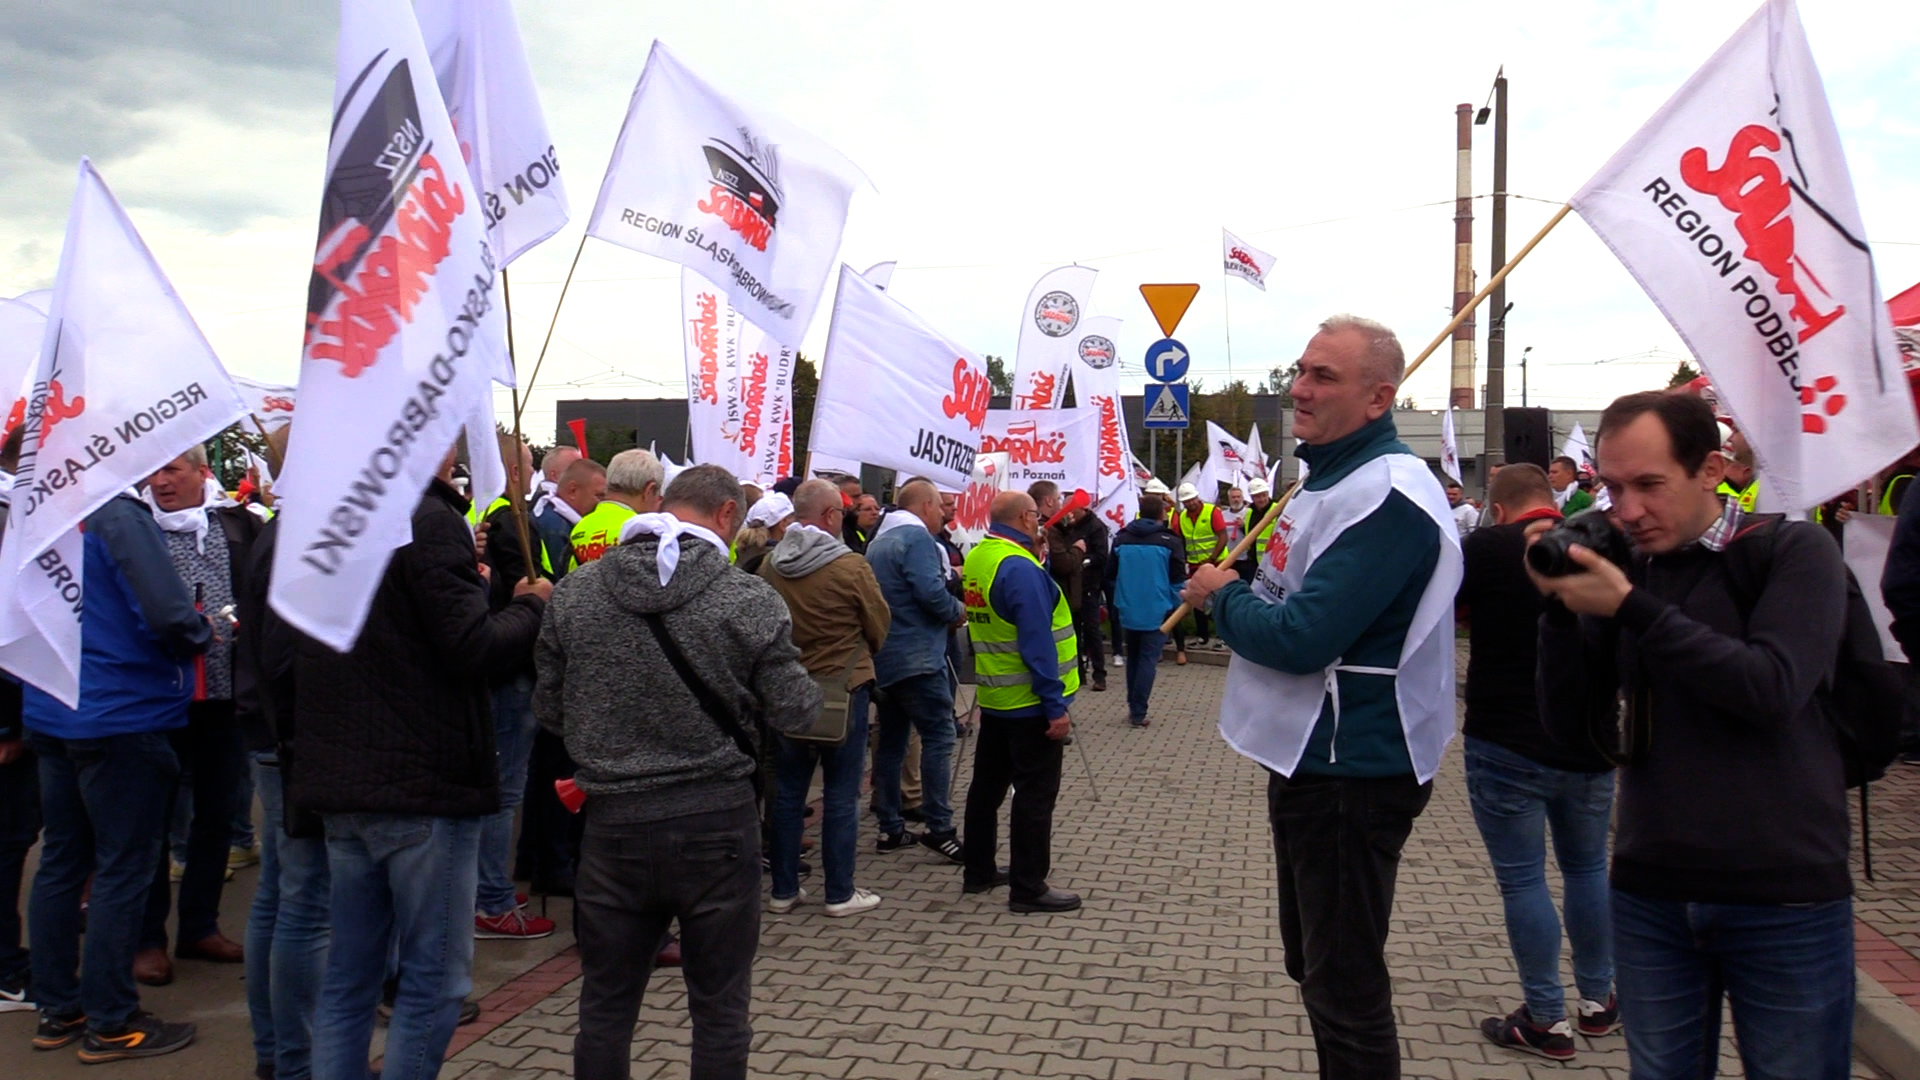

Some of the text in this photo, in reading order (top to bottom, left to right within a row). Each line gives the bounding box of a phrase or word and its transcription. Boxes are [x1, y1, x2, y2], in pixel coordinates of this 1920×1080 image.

[620, 207, 684, 239] REGION
[1642, 176, 1741, 278] REGION
[726, 337, 737, 368] KWK
[691, 373, 701, 405] NSZZ
[729, 377, 738, 393] SA
[728, 395, 741, 423] JSW
[770, 394, 784, 424] KWK
[767, 431, 779, 447] SA
[763, 448, 775, 476] JSW
[1023, 467, 1066, 481] Poznań
